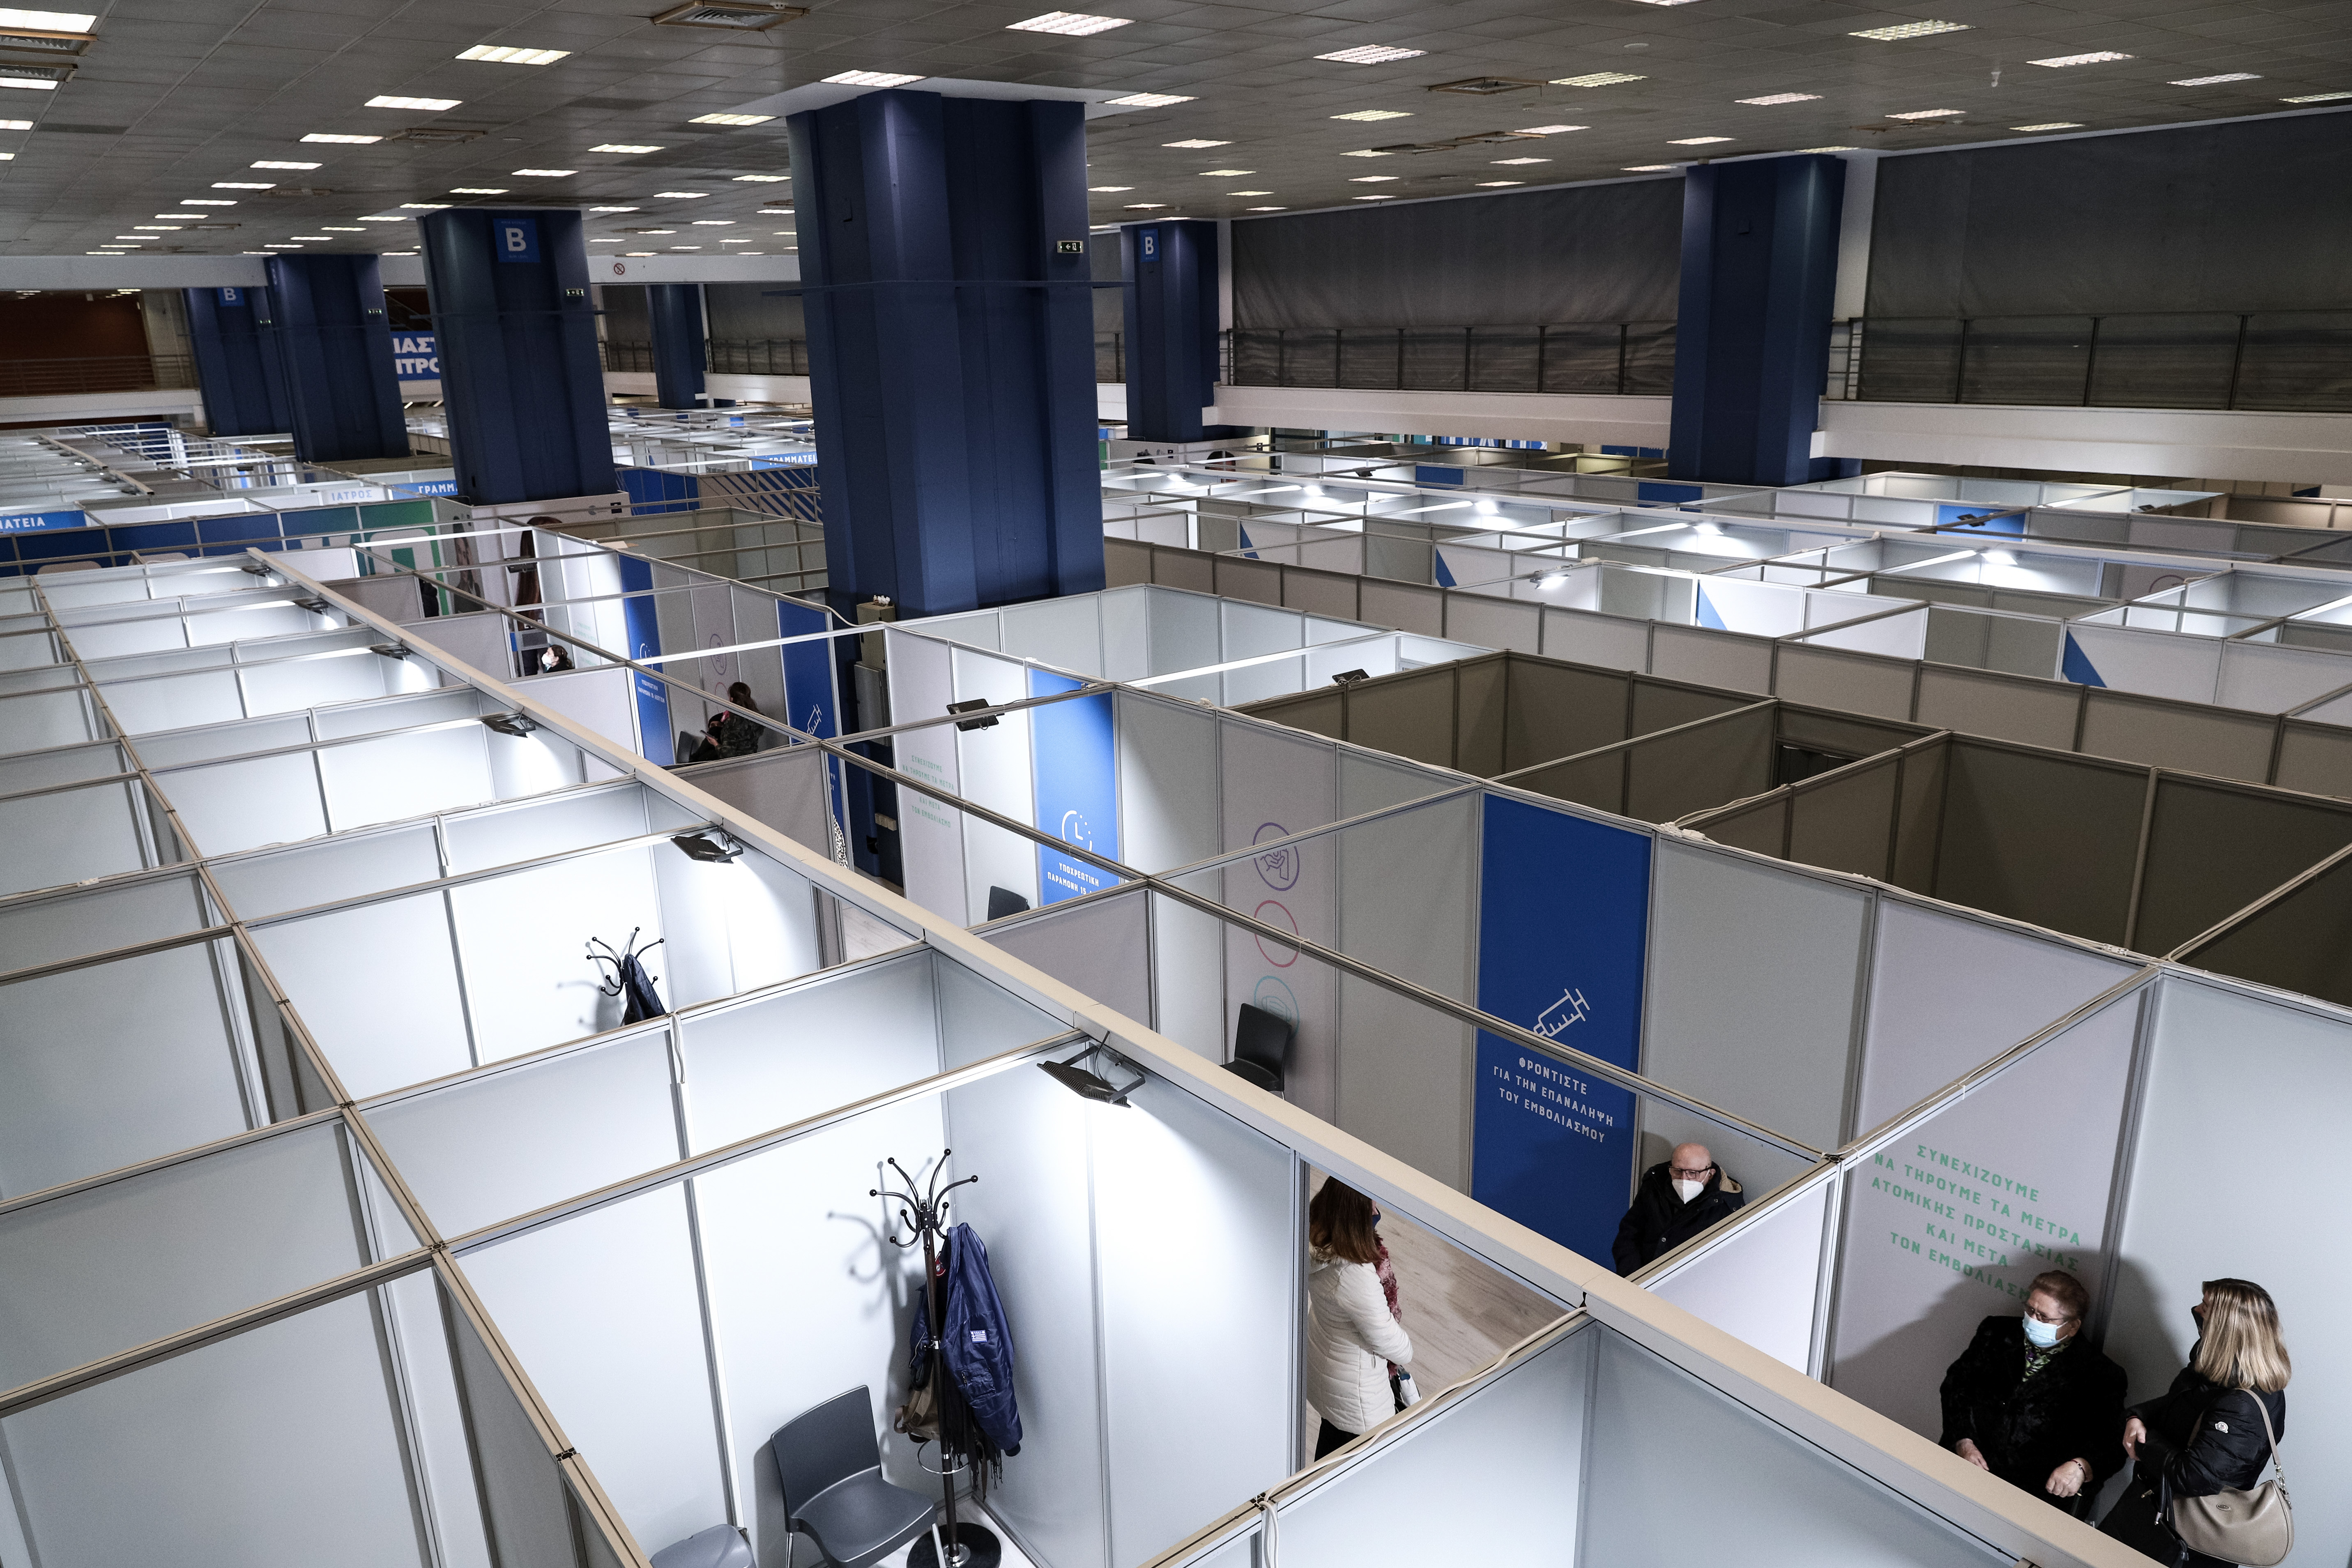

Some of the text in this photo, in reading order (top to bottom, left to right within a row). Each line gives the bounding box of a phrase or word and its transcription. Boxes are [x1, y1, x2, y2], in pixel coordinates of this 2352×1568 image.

[505, 228, 527, 252] B
[1145, 236, 1154, 255] B
[769, 454, 817, 465] ΓΡΑΜΜΑΤΕΙ
[331, 490, 372, 501] ΙΑΤΡΟΣ
[911, 755, 942, 773] ΣΥΝΕΧΙΖΟΥΜΕ
[910, 767, 930, 781] ΤΗΡΟΥΜΕ
[939, 779, 954, 791] ΜΕΤΡΑ
[929, 800, 941, 810] ΜΕΤΑ
[1047, 871, 1086, 895] ΠΑΡΑΜΟΝΗ 15
[1059, 862, 1099, 887] ΥΠΟΧΡΕΩΤΙΚΗ
[1519, 1057, 1587, 1095] ΦΡΟΝΤΙΣΤΕ
[1494, 1066, 1613, 1127] ΓΙΑ ΤΗΝ ΕΠΑΝΑΛΗΨΗ
[1499, 1087, 1605, 1143] ΤΟΥ ΕΜΒΟΛΙΑΣΜΟΥ
[1917, 1145, 2039, 1202] ΣΥΝΕΧΙΖΟΥΜΕ
[1875, 1153, 2080, 1246] ΝΑ ΤΗΡΟΥΜΕ ΤΑ ΜΕΤΡΑ
[1872, 1177, 2078, 1272] ΑΤΟΜΙΚΗΣ ΠΡΟΣΤΑΣΙΑΣ
[1926, 1223, 2008, 1267] ΚΑΙ ΜΕΤΑ
[1891, 1232, 2030, 1300] ΤΟΝ ΕΜΒΟΛΙΑΣΜ
